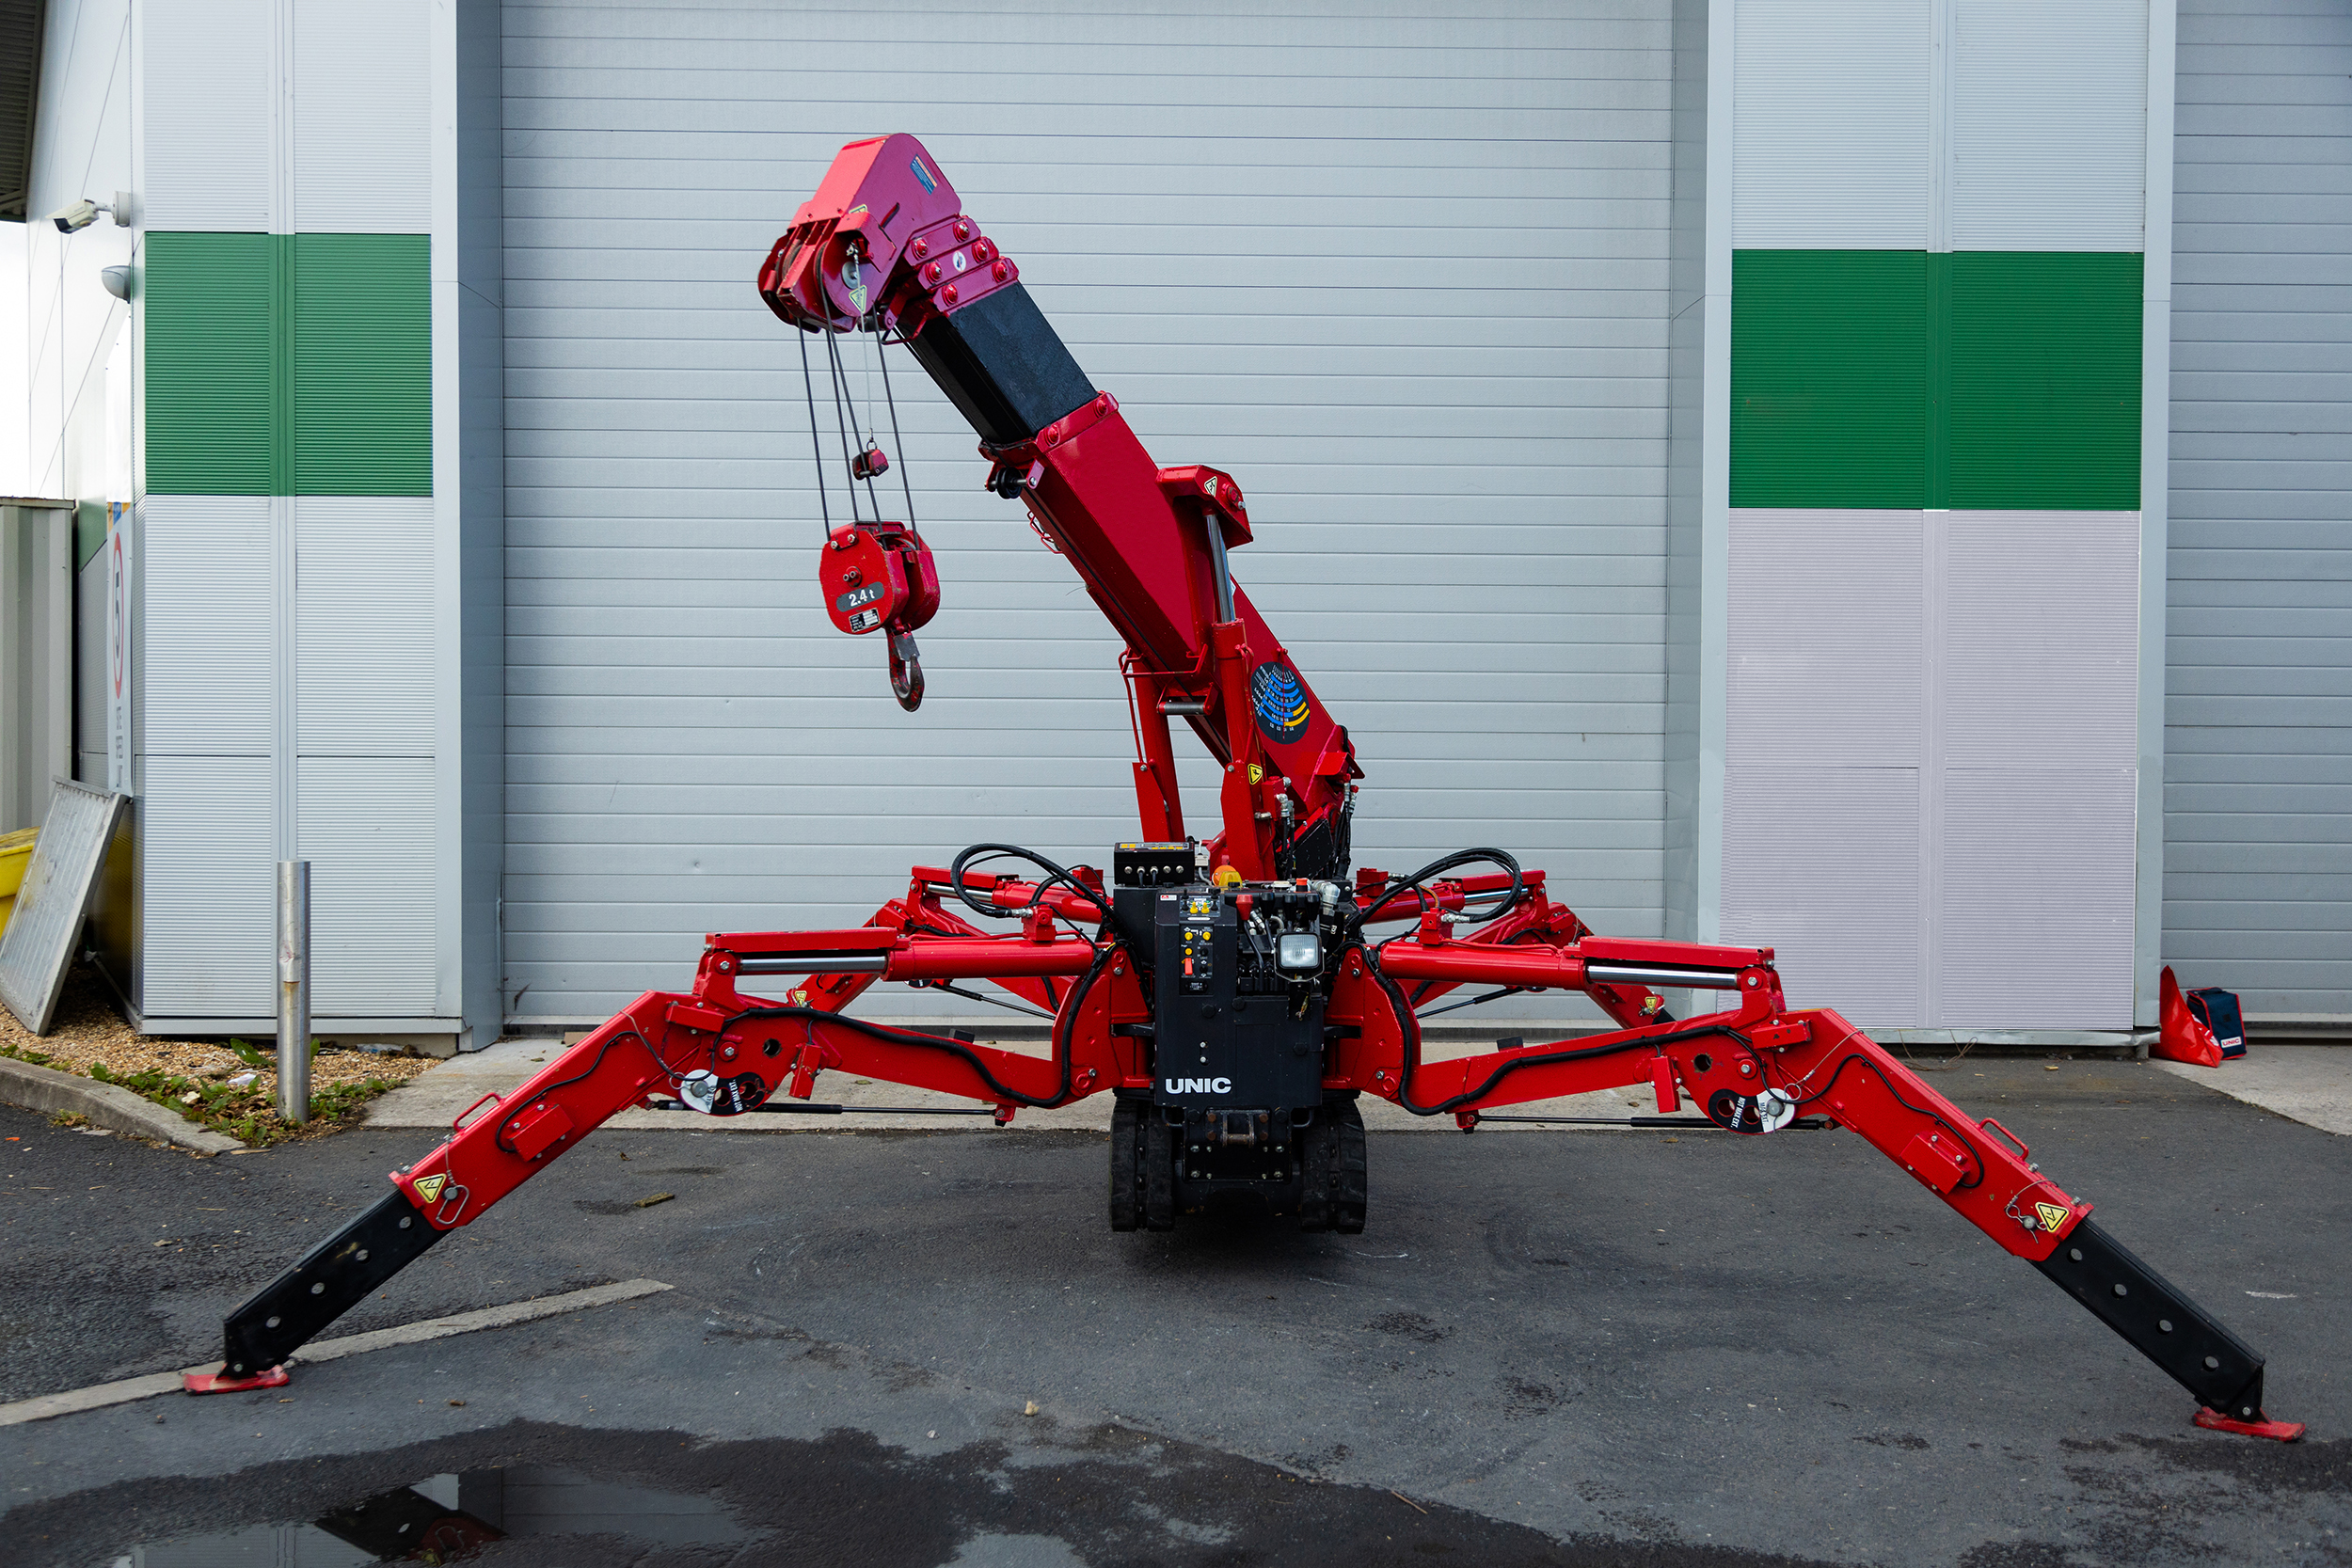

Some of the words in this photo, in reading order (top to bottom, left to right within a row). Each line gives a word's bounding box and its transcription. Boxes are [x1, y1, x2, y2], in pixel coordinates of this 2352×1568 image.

[849, 589, 867, 607] 2.4
[868, 589, 876, 599] t
[115, 571, 120, 658] 5
[1166, 1077, 1232, 1094] UNIC
[731, 1090, 740, 1101] MAX
[1737, 1096, 1746, 1108] NOT
[734, 1101, 743, 1112] NOT
[1733, 1106, 1743, 1119] MAX
